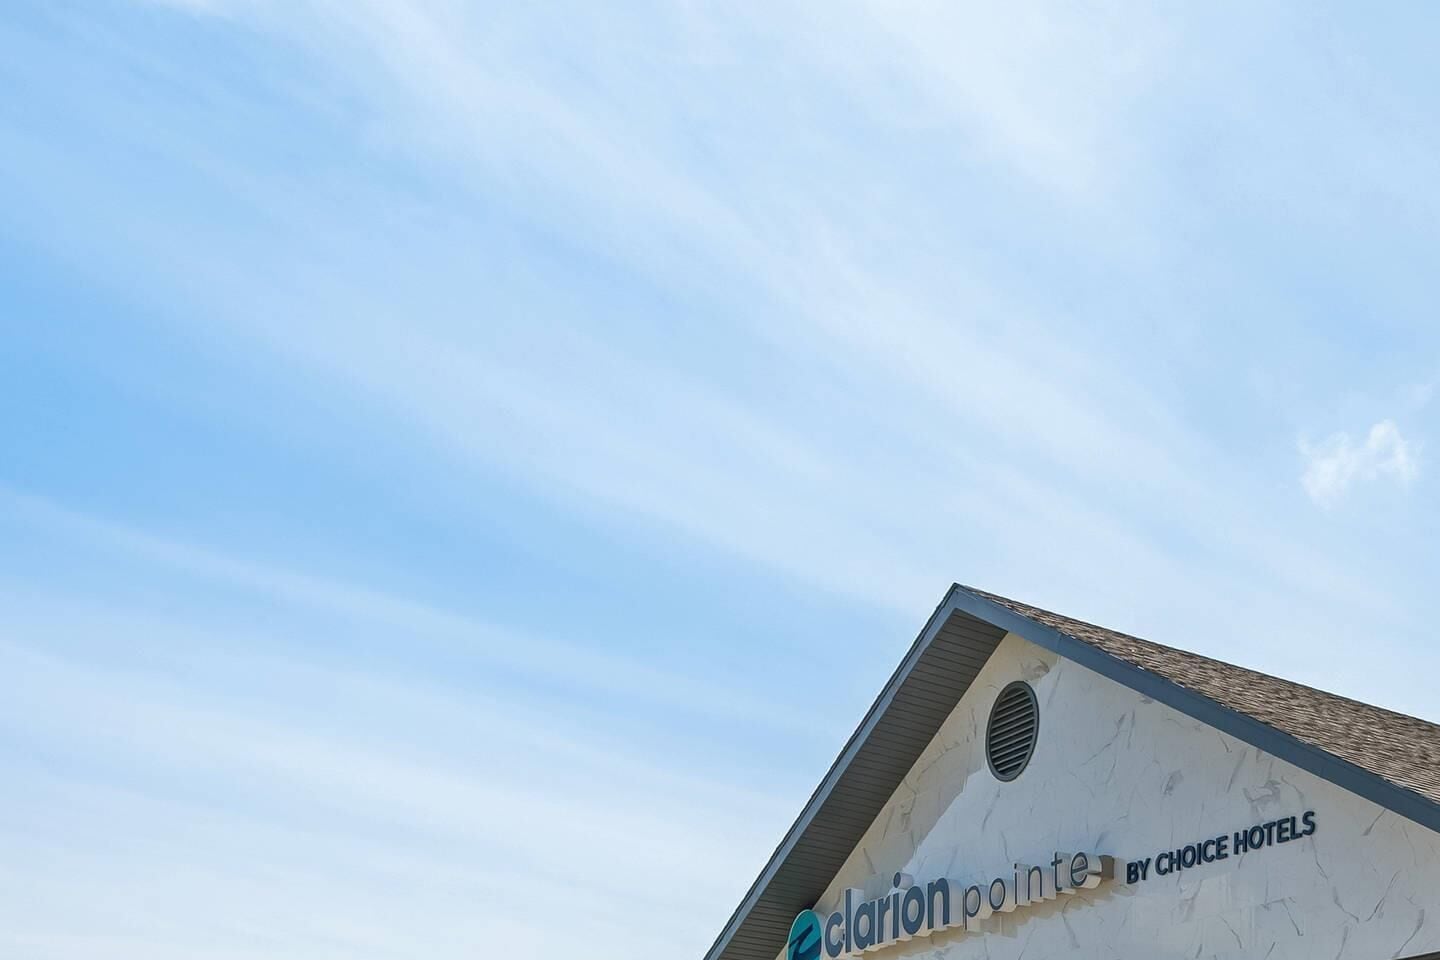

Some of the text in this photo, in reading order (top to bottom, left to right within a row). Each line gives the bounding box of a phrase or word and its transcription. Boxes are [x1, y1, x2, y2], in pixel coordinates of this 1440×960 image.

[825, 811, 1316, 958] clarion pointe BY CHOICE HOTELS
